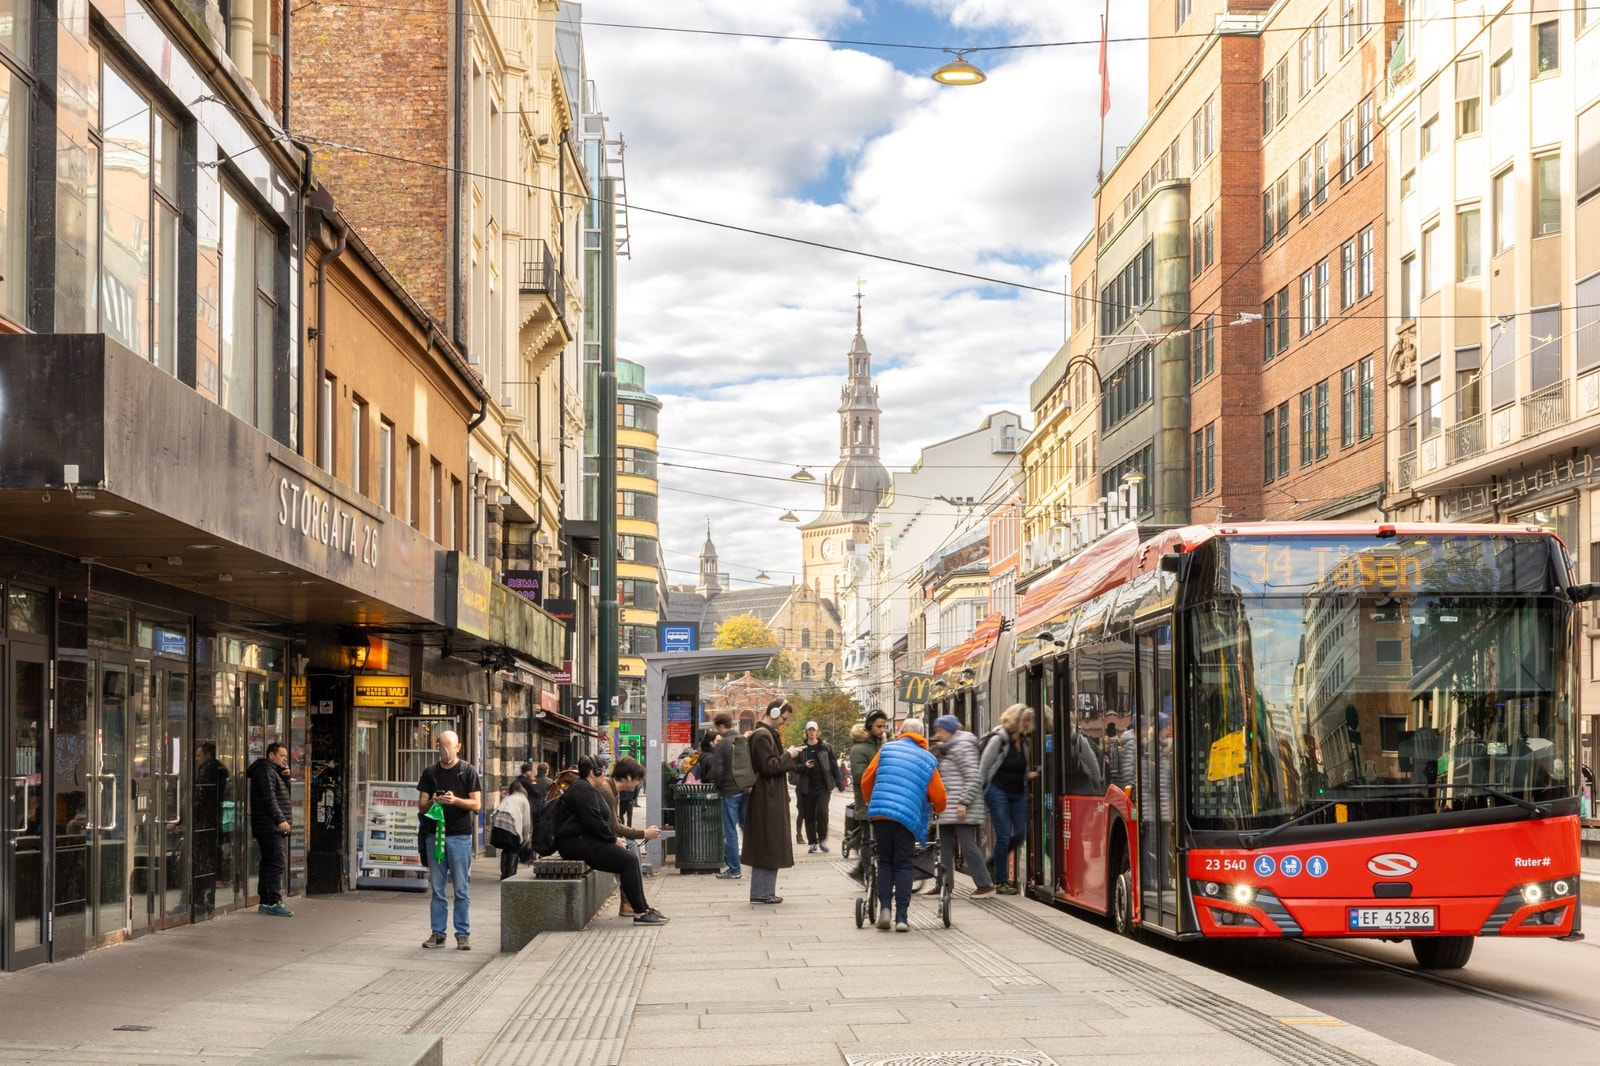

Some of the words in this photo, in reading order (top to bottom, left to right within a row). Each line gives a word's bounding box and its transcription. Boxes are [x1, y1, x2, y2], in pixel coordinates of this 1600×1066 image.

[278, 477, 358, 558] STORGATA
[363, 524, 378, 569] 26
[1250, 544, 1293, 585] 34
[1310, 544, 1423, 586] Tåsen
[508, 578, 539, 588] REMA
[576, 699, 598, 715] 15
[1205, 859, 1220, 870] 23
[1224, 859, 1246, 870] 540
[1515, 857, 1551, 867] Ruter#
[1363, 912, 1378, 924] EF
[1385, 911, 1430, 924] 45286
